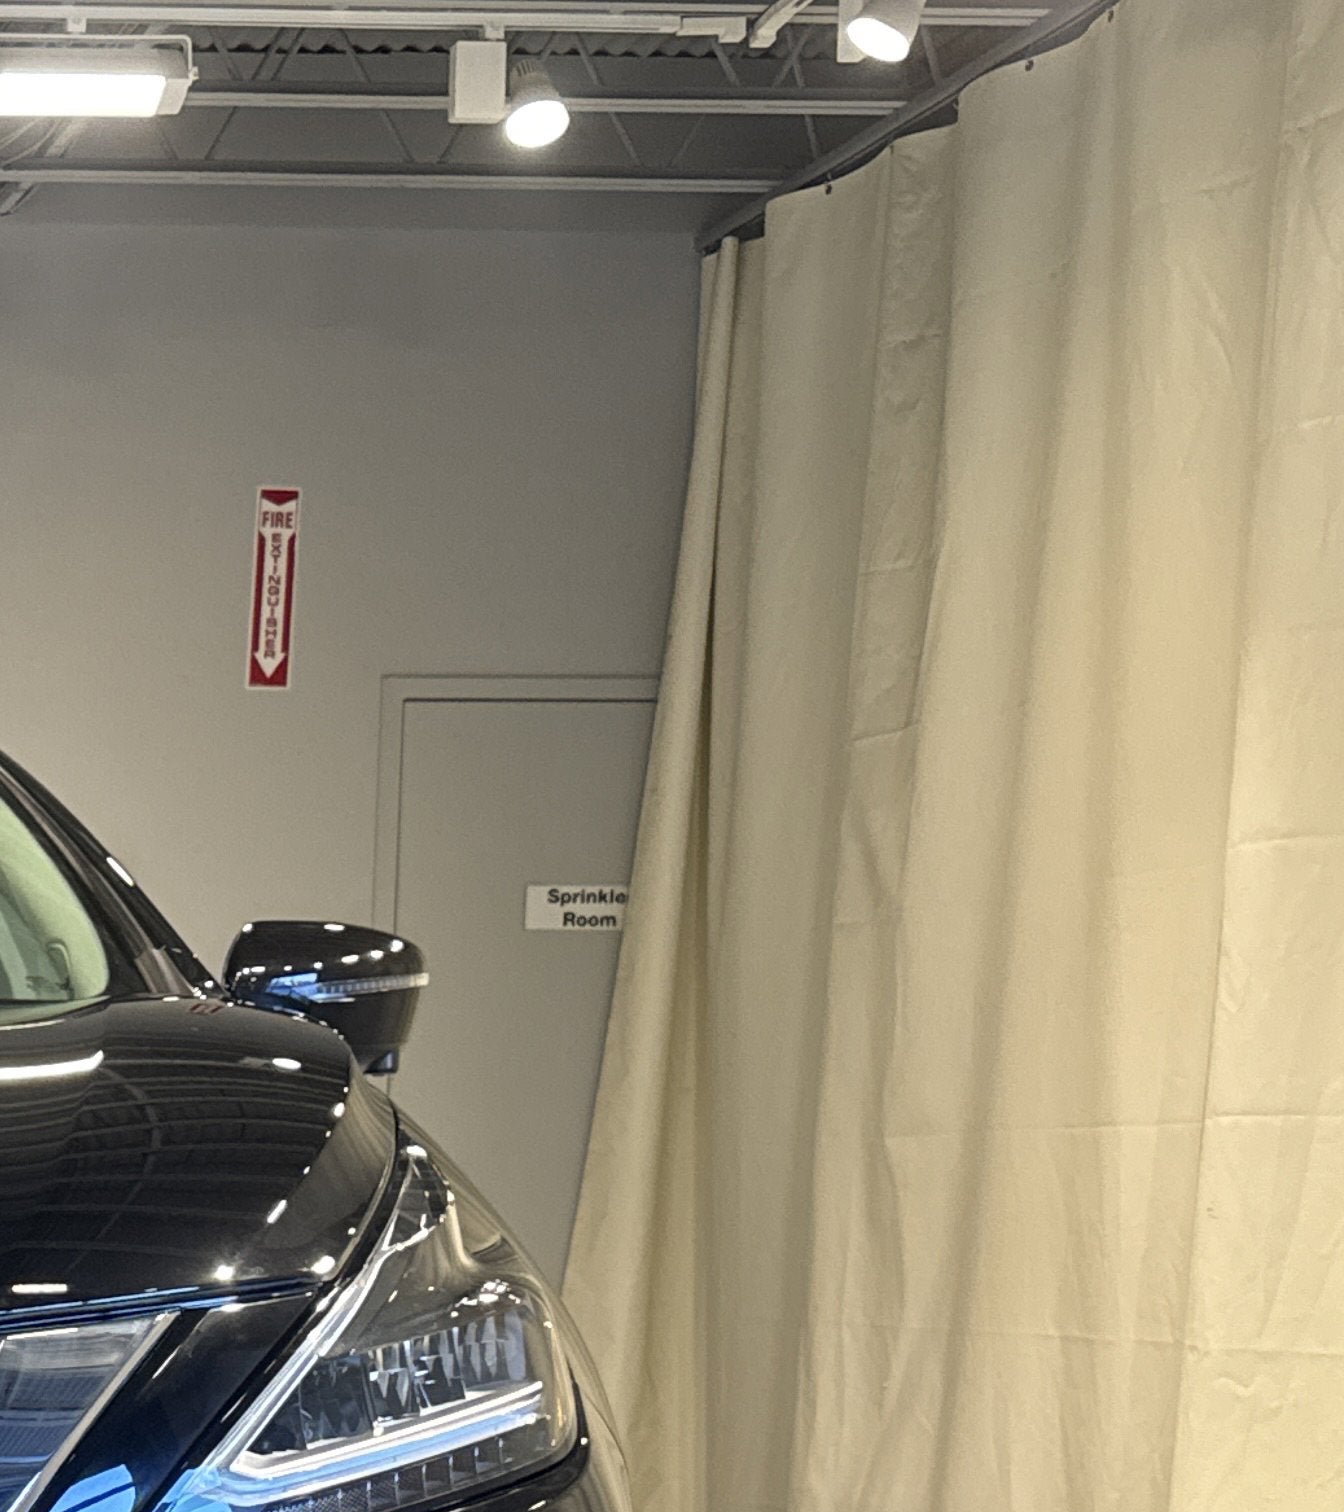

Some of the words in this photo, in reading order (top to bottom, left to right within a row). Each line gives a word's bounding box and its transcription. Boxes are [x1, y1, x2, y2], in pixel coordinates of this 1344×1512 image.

[262, 511, 294, 529] FIRE
[263, 533, 282, 659] EXTINGUISHER
[547, 888, 629, 906] Sprinkle
[562, 911, 617, 927] Room
